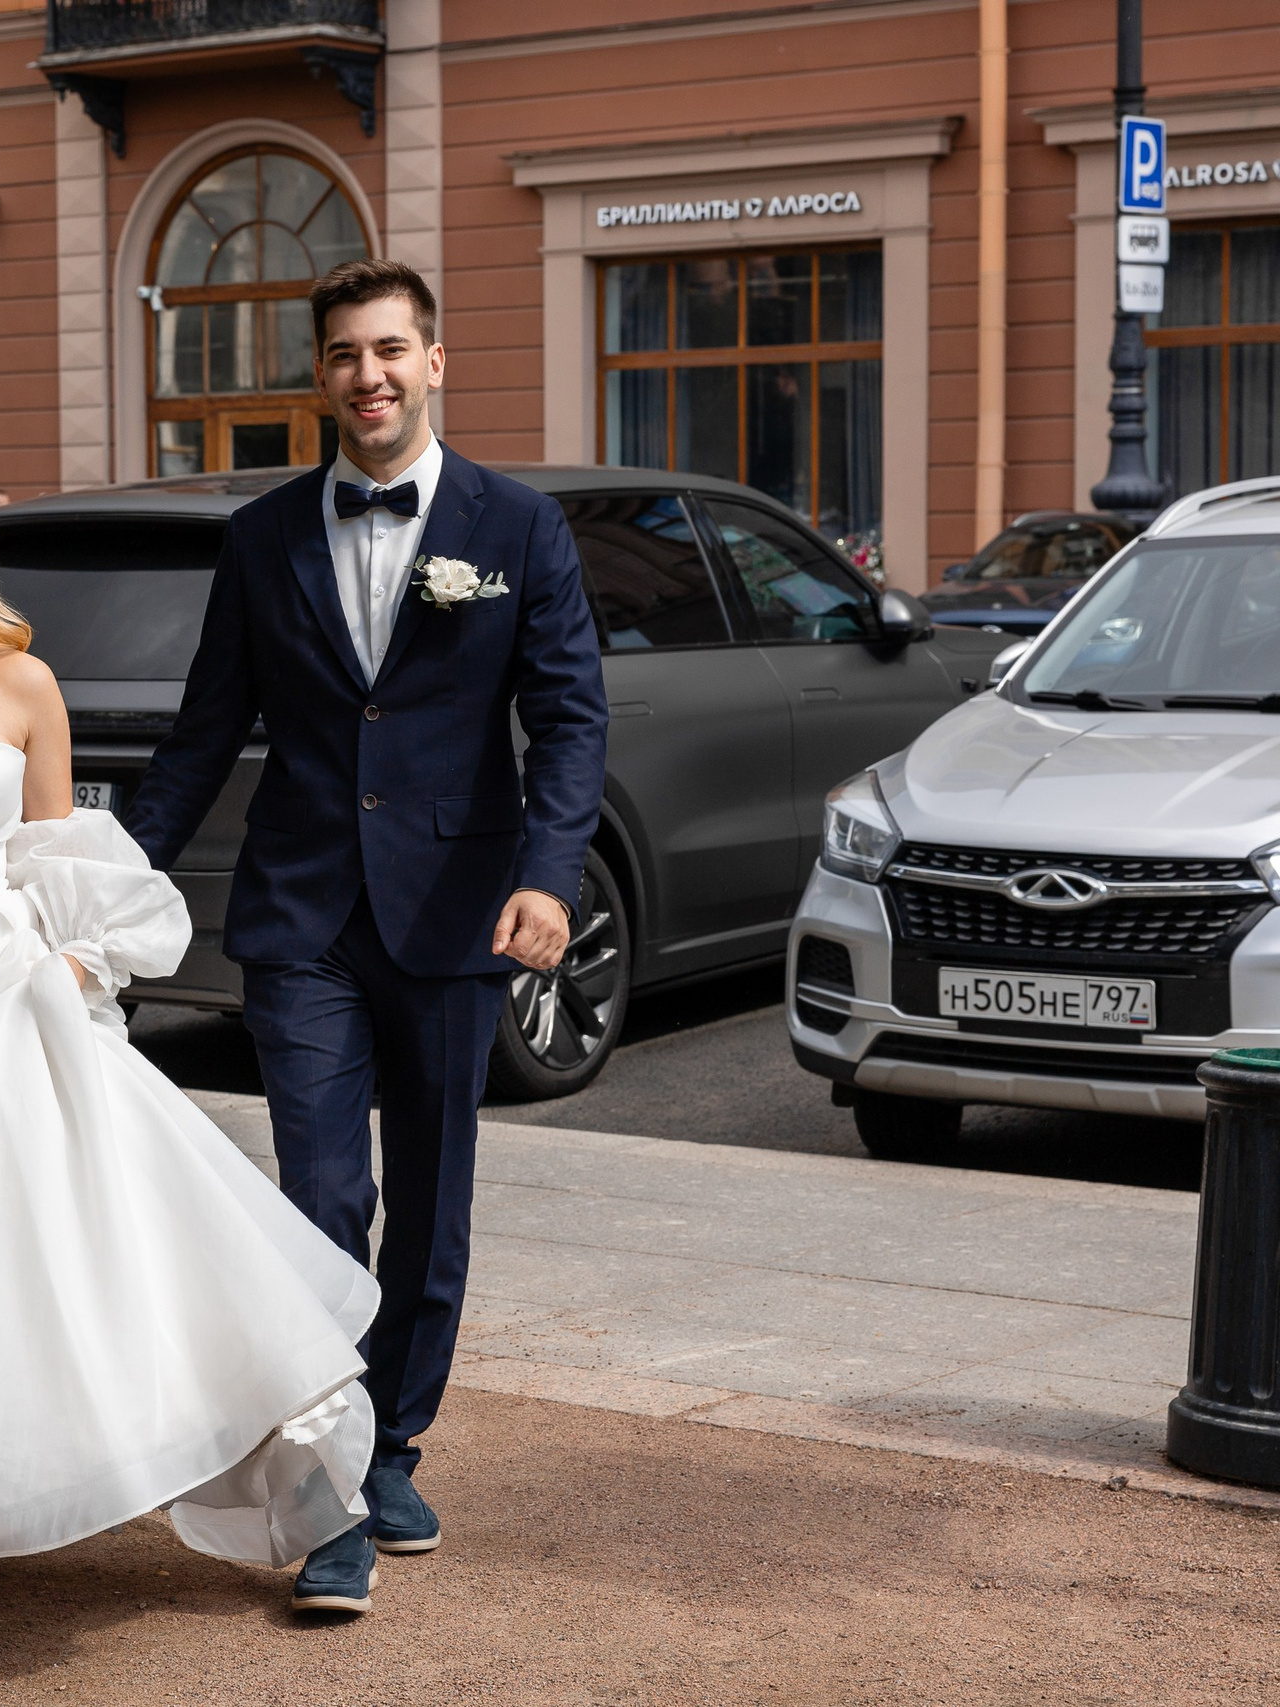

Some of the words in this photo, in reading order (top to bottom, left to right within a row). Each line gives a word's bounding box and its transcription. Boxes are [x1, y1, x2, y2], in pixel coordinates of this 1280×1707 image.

[1132, 129, 1158, 200] P
[1164, 160, 1268, 188] ALROSA
[597, 199, 740, 227] БРИЛЛИАНТЫ
[1088, 984, 1141, 1013] 797
[1103, 1011, 1129, 1024] RUS
